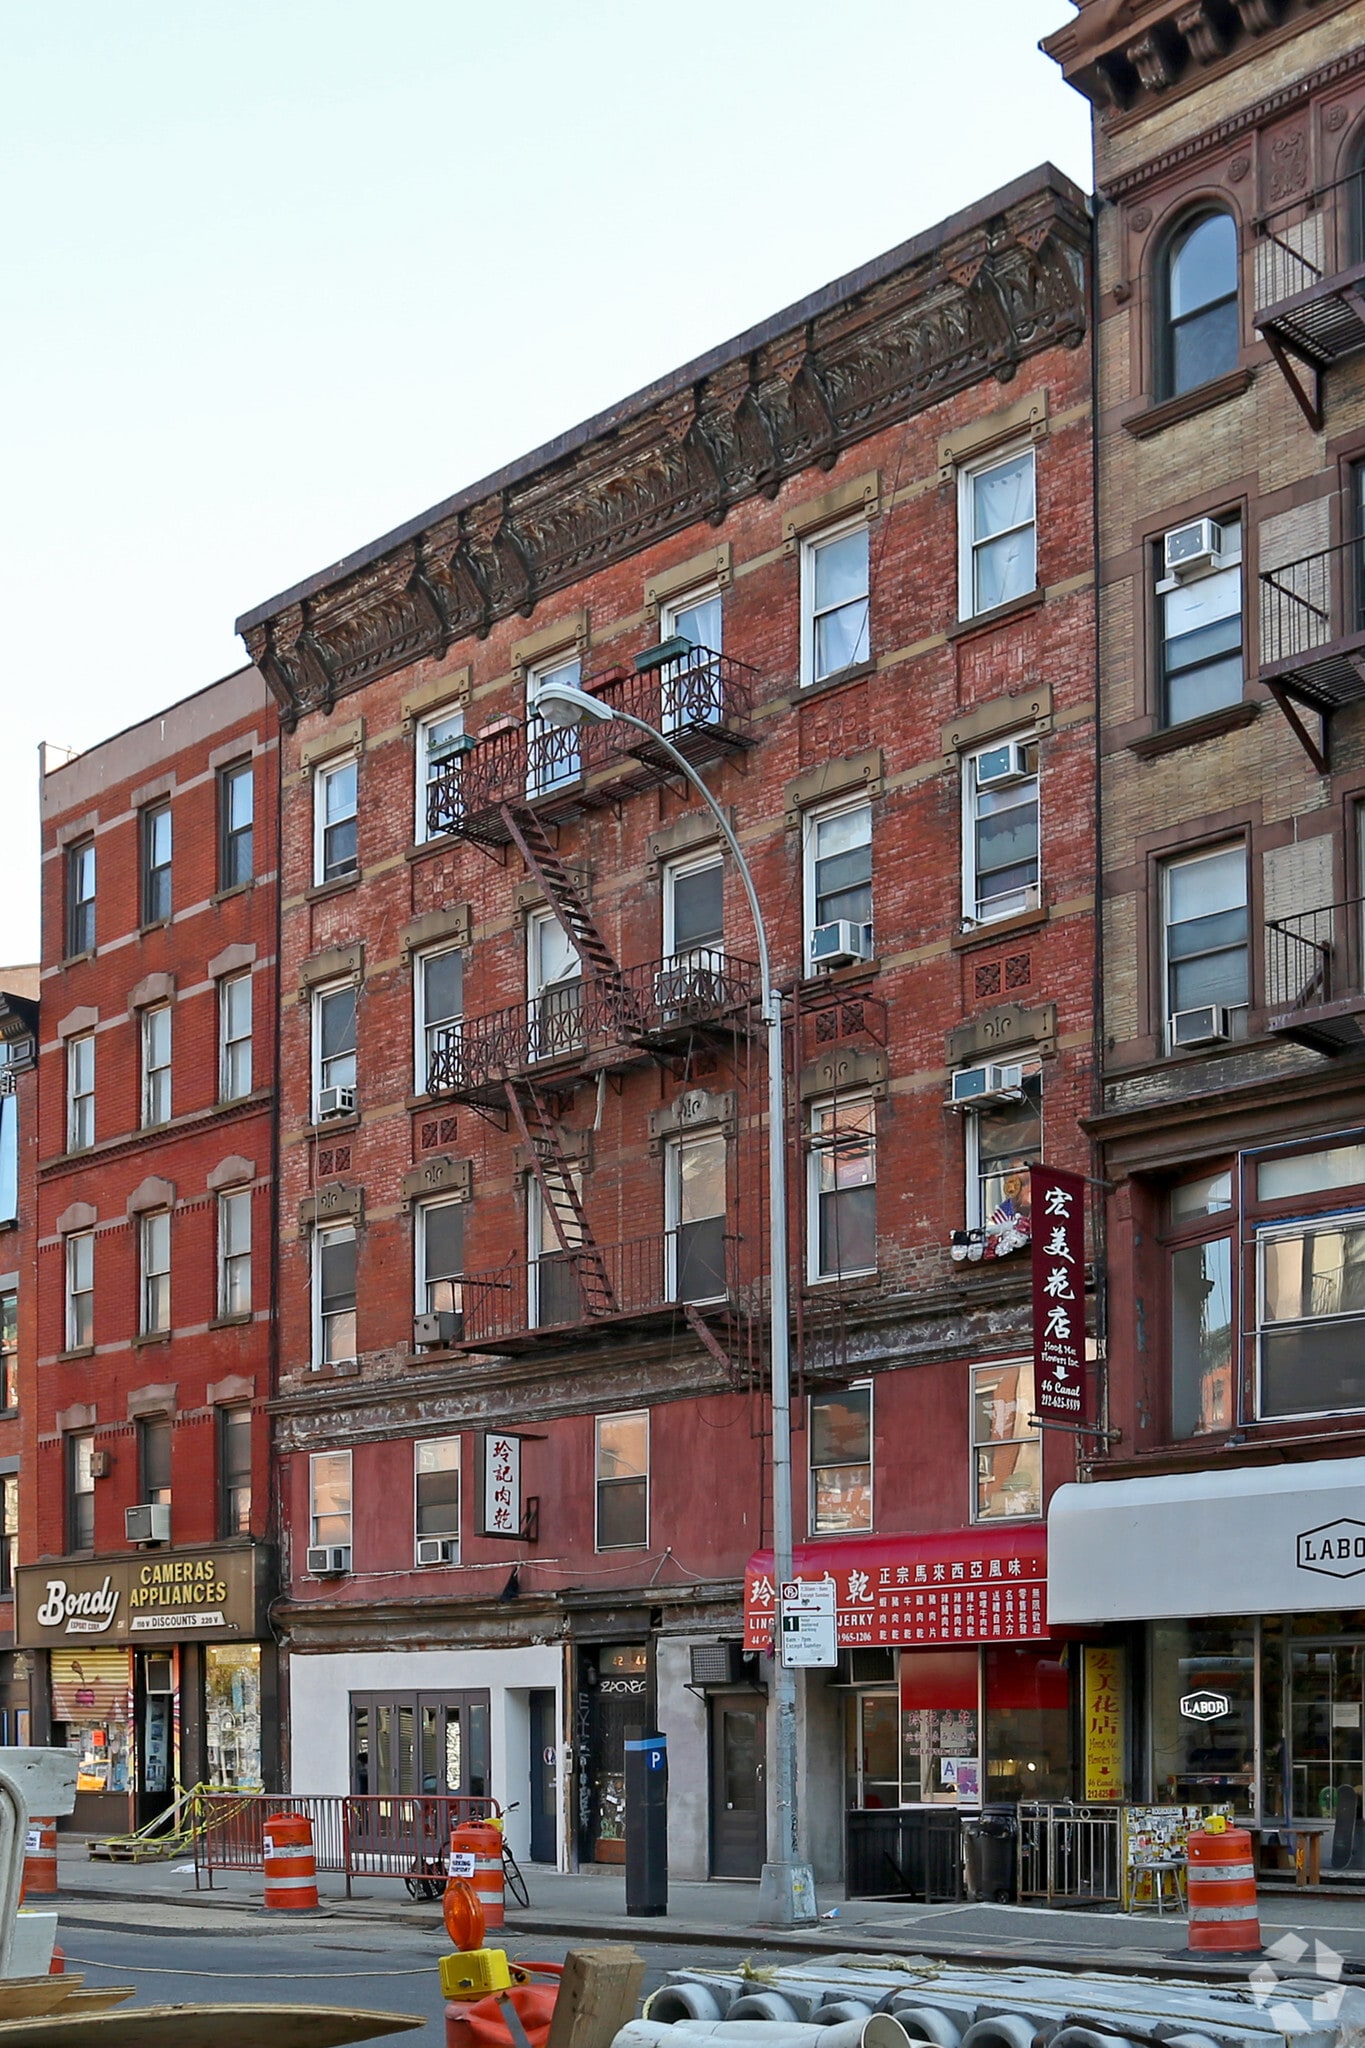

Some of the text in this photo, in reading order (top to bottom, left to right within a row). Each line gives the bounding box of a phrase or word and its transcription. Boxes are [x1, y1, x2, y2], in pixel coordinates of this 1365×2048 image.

[1043, 1186, 1076, 1340] 宏美花店
[1041, 1352, 1067, 1365] Flowers
[1041, 1379, 1081, 1397] 46 Canal
[493, 1440, 513, 1530] 玲記肉乾
[140, 1560, 214, 1585] CAMERAS
[37, 1575, 121, 1630] Bondy
[130, 1581, 227, 1608] APPLIANCES
[152, 1614, 197, 1628] DISCOUNTS
[201, 1617, 213, 1625] 220
[213, 1616, 218, 1624] V
[787, 1616, 794, 1631] 1
[837, 1613, 873, 1627] JERKY
[842, 1632, 872, 1643] 965-1206
[1184, 1700, 1224, 1714] LABOR
[651, 1751, 660, 1769] P
[943, 1760, 955, 1776] A
